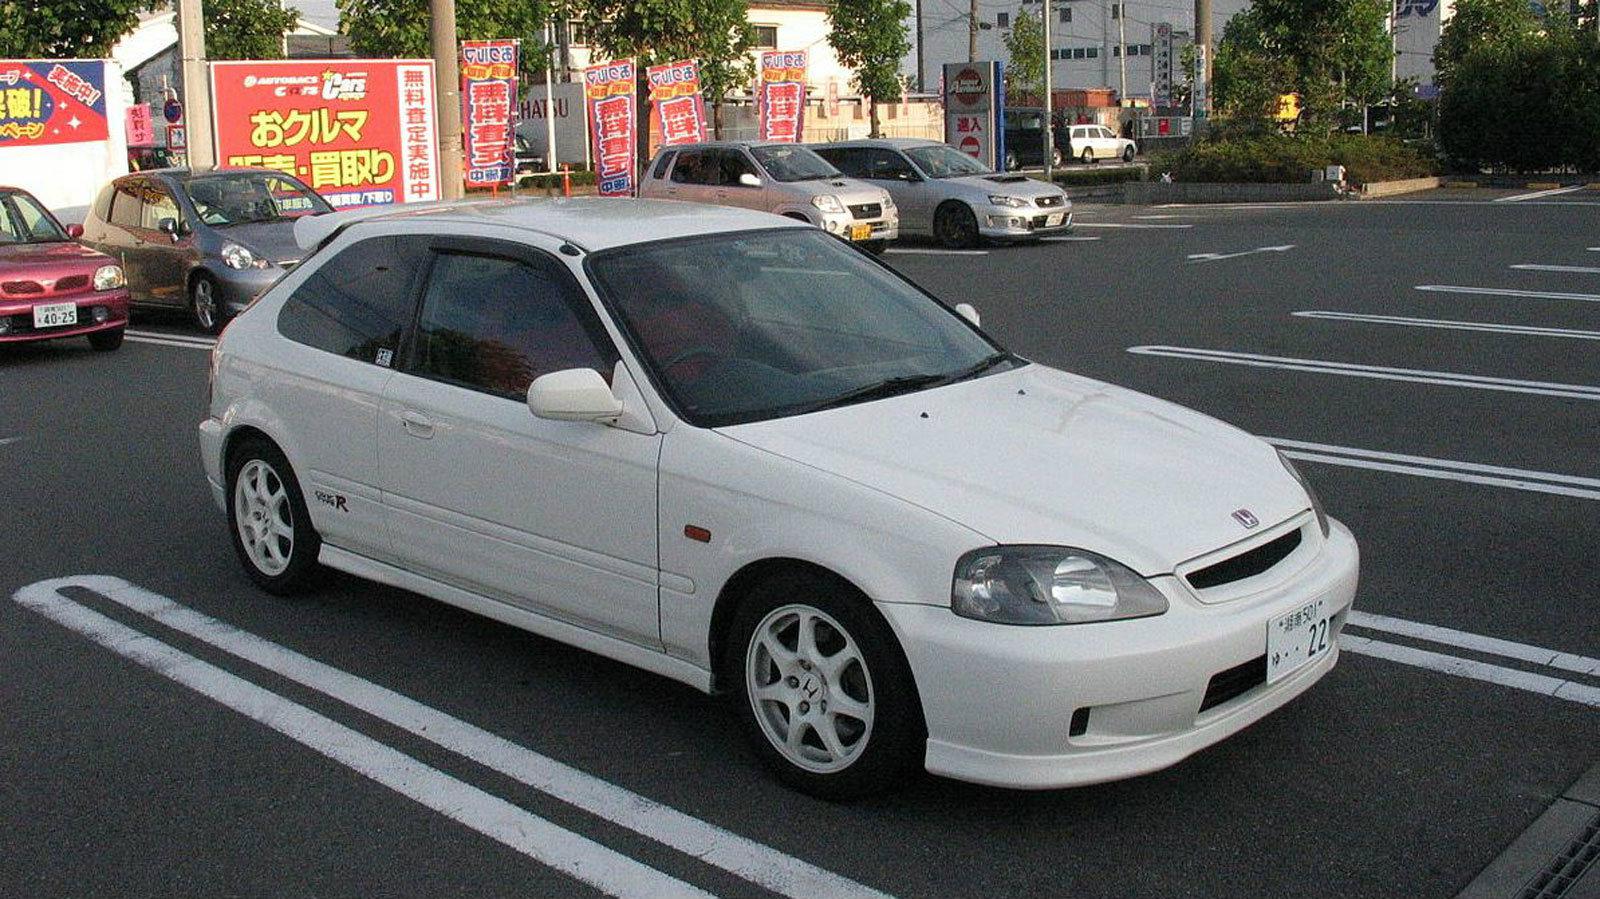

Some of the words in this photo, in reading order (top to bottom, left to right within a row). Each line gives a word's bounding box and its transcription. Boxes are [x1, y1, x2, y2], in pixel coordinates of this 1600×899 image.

[250, 107, 369, 148] おクルマ
[404, 70, 430, 198] 無料査定実施中
[1307, 618, 1328, 657] 22
